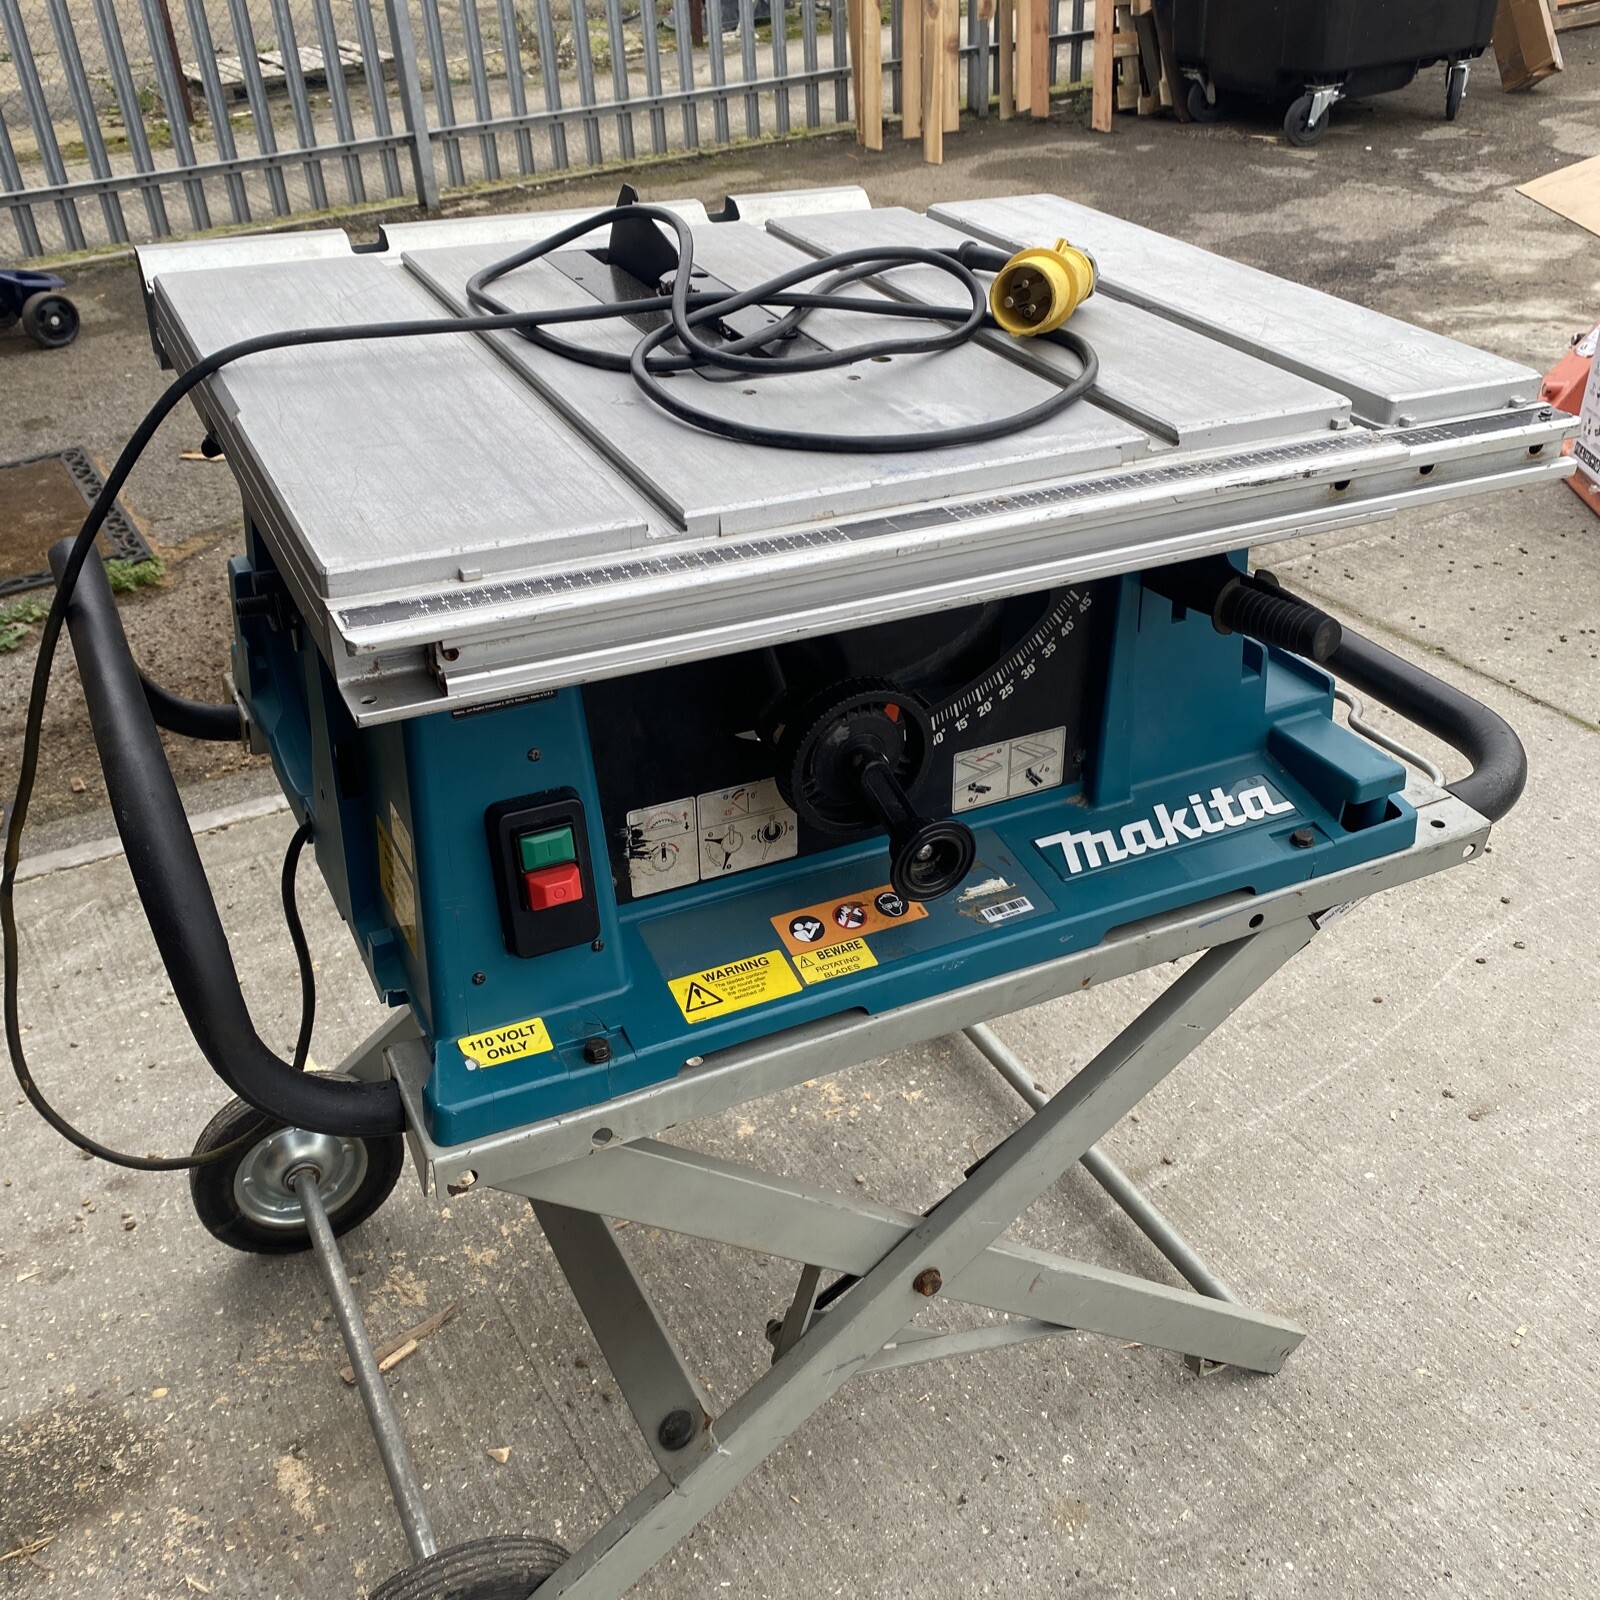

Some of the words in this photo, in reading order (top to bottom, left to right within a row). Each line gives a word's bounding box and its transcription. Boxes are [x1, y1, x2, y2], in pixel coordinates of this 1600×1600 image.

[816, 940, 863, 960] BEWARE
[701, 957, 770, 982] WARNING
[815, 955, 860, 972] ROTATING
[823, 964, 860, 978] BLADES
[745, 970, 768, 980] continue
[738, 984, 760, 992] machine
[469, 1037, 494, 1050] 110
[496, 1024, 535, 1043] VOLT
[487, 1040, 527, 1059] ONLY
